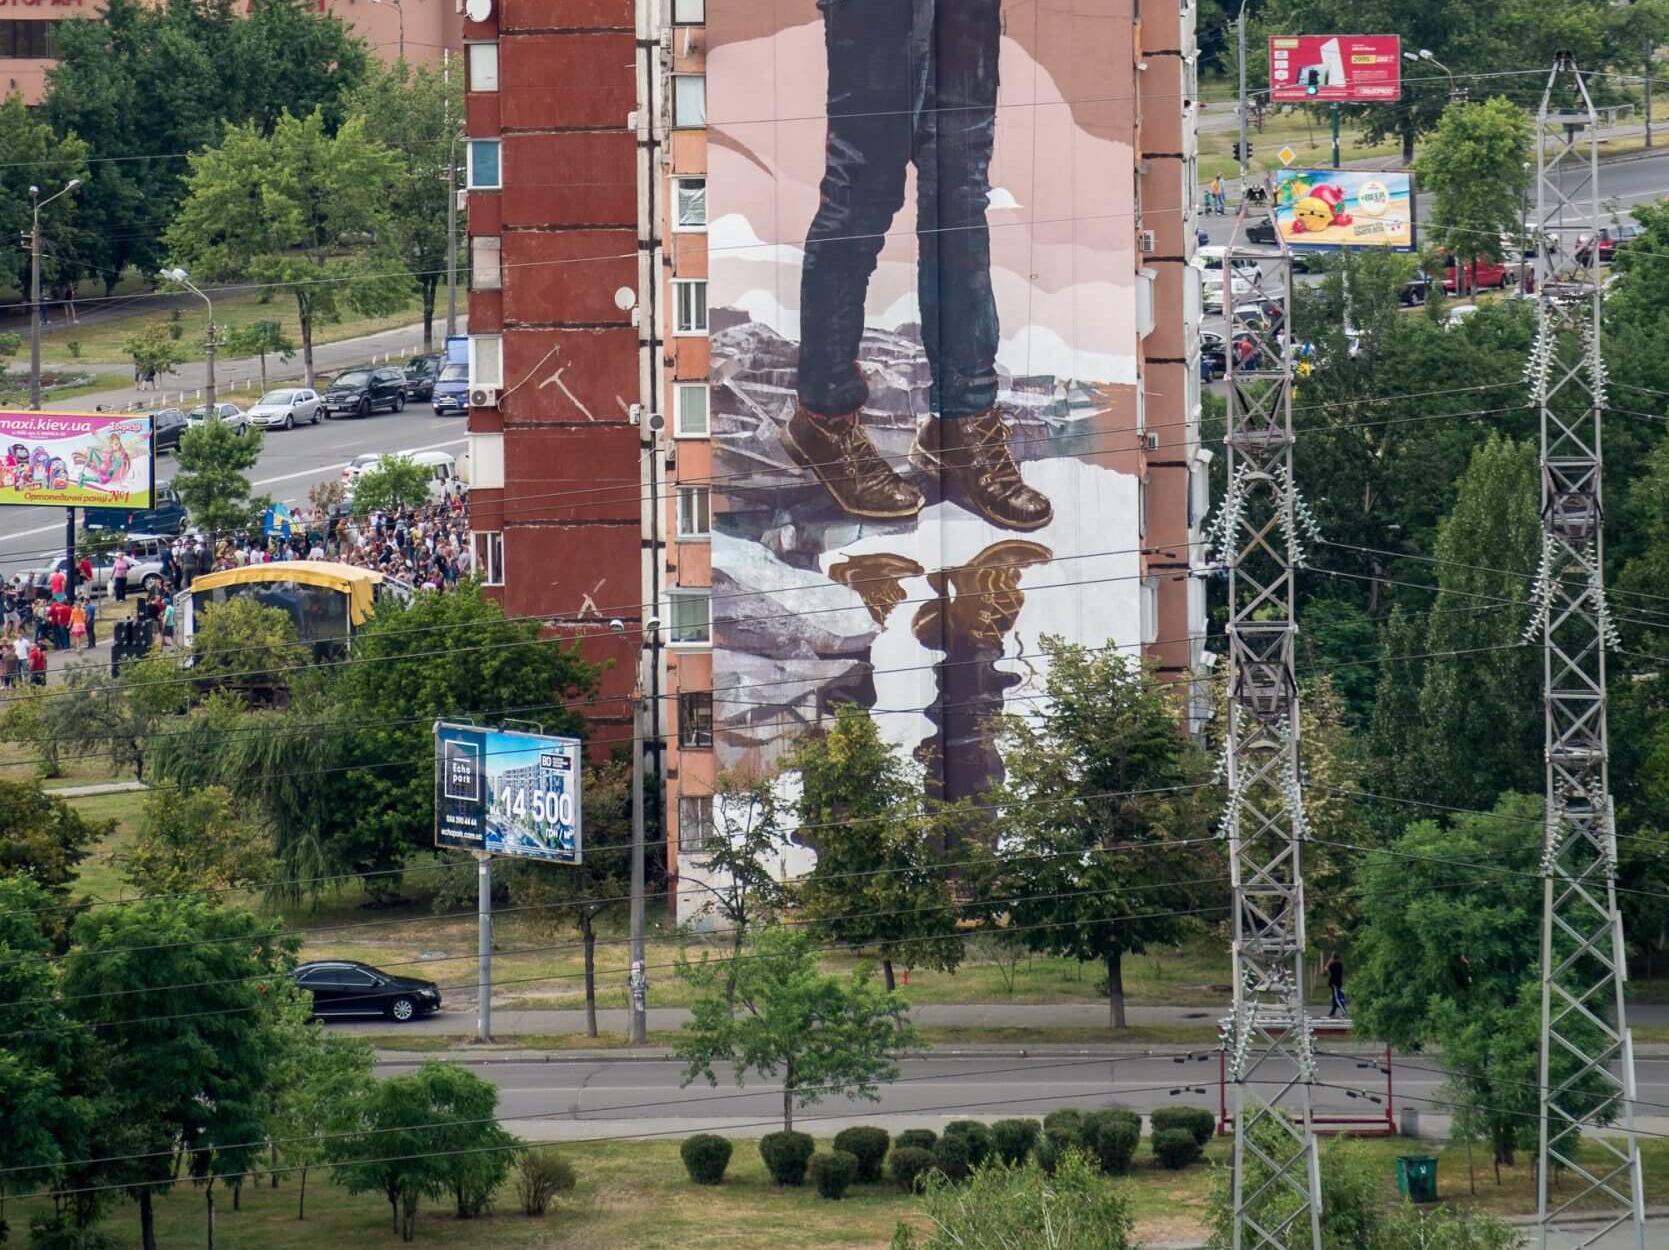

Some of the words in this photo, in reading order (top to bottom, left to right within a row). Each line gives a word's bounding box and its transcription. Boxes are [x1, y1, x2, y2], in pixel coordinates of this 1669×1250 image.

[452, 762, 471, 775] Echo
[452, 774, 471, 784] park
[501, 786, 526, 819] 14
[532, 789, 572, 826] 500
